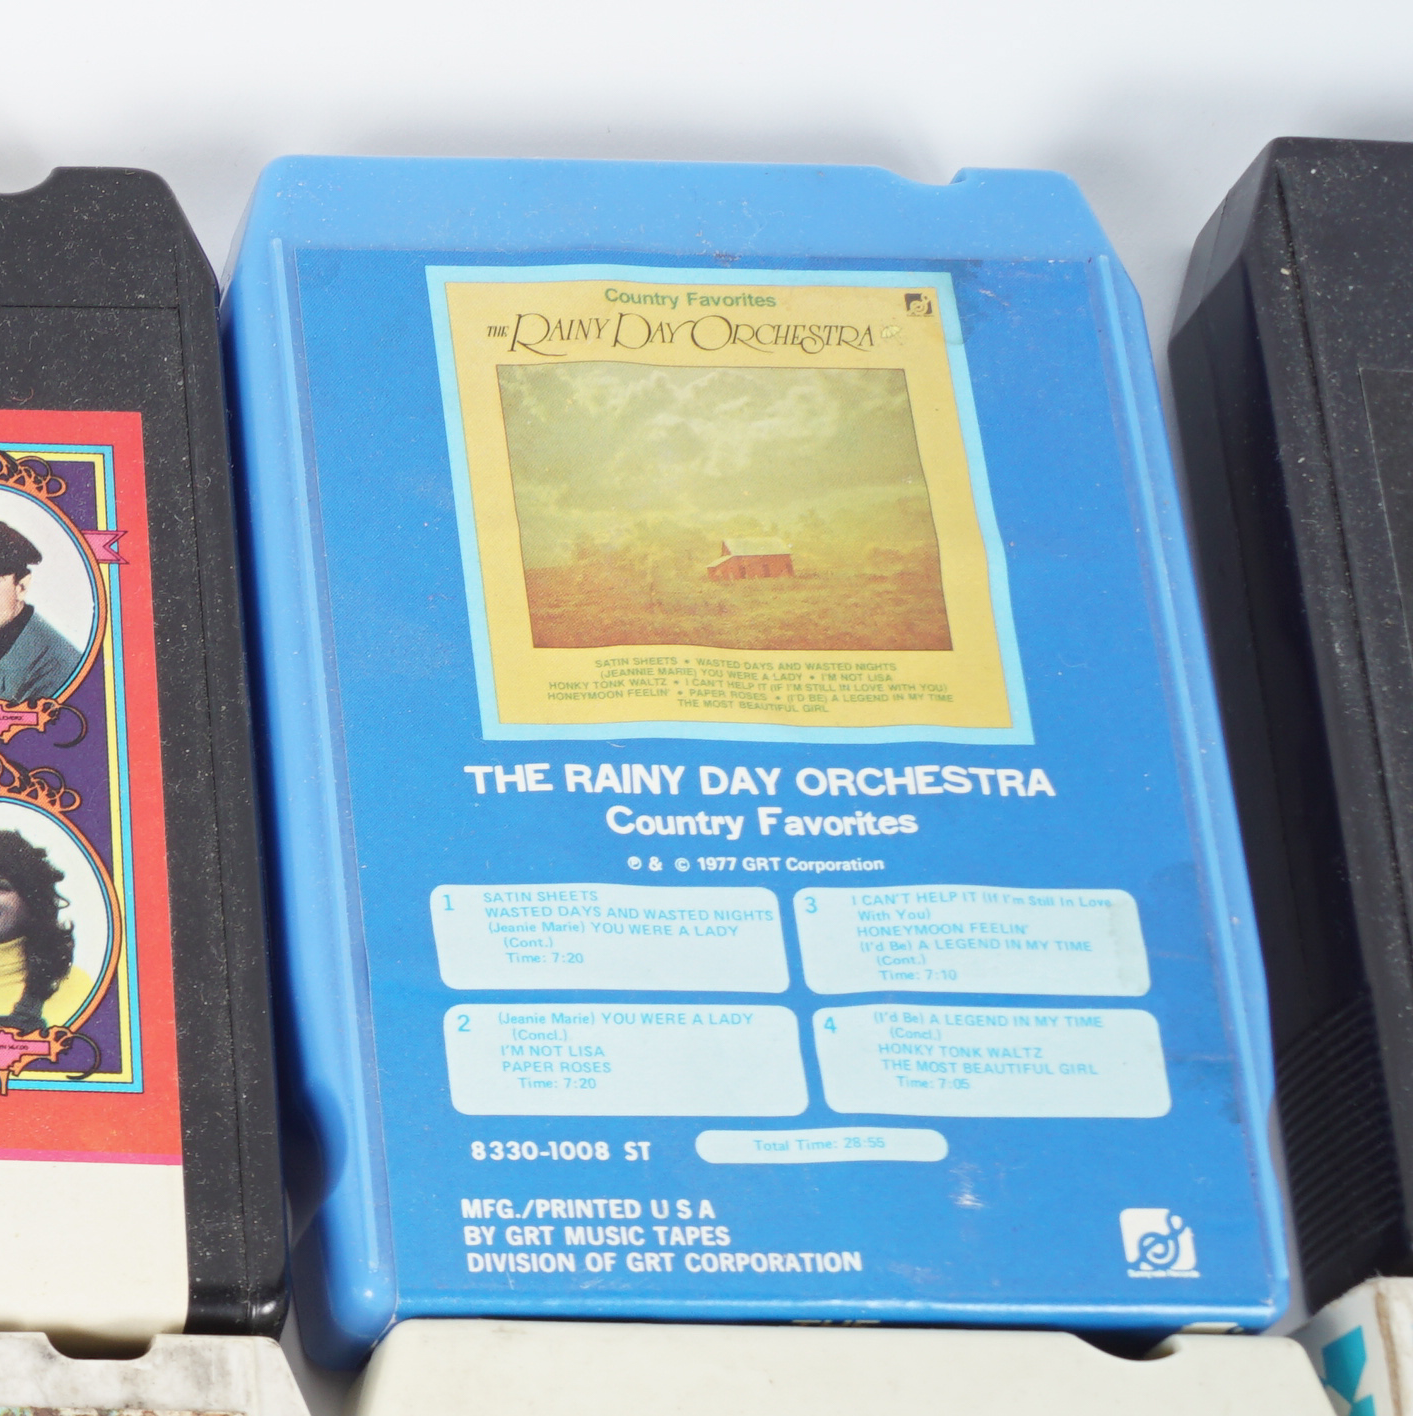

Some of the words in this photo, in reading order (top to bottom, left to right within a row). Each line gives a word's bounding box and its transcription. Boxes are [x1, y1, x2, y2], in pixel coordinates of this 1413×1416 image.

[604, 288, 679, 309] Country
[686, 292, 776, 307] Favorites
[487, 326, 509, 339] THE
[509, 313, 609, 357] RAINY
[612, 313, 689, 349] DAY
[692, 315, 875, 354] ORCHESTRA
[464, 763, 553, 794] THE
[564, 763, 685, 794] RAINY
[699, 765, 781, 795] DAY
[796, 765, 1055, 796] ORCHESTRA
[606, 805, 744, 840] Country
[757, 807, 918, 836] Favorites
[697, 856, 737, 871] 1977
[742, 857, 781, 871] GRT
[785, 857, 884, 873] Corporation
[483, 891, 531, 903] SATIN
[537, 890, 598, 902] SHEETS
[485, 906, 552, 918] WASTED
[557, 906, 601, 917] DAYS
[606, 907, 639, 919] AND
[643, 909, 709, 920] WASTED
[713, 910, 773, 921] NIGHTS
[857, 923, 963, 937] HONEYMOON
[969, 922, 1028, 934] FEELIN'
[882, 1059, 911, 1071] THE
[916, 1060, 957, 1073] MOST
[962, 1062, 1053, 1074] BEAUTIFUL
[1059, 1063, 1098, 1075] GIRL
[471, 1141, 609, 1160] 8330-1008
[624, 1141, 650, 1160] ST
[753, 1139, 789, 1151] Total
[795, 1139, 837, 1150] Time:
[843, 1136, 885, 1148] 28:55
[464, 1226, 495, 1245] BY
[505, 1226, 554, 1245] GRT
[564, 1226, 645, 1245] MUSIC
[652, 1226, 730, 1246] TAPES
[467, 1252, 575, 1272] DIVISION
[585, 1252, 616, 1272] OF
[626, 1252, 675, 1272] GRT
[685, 1251, 861, 1272] CORPORATION
